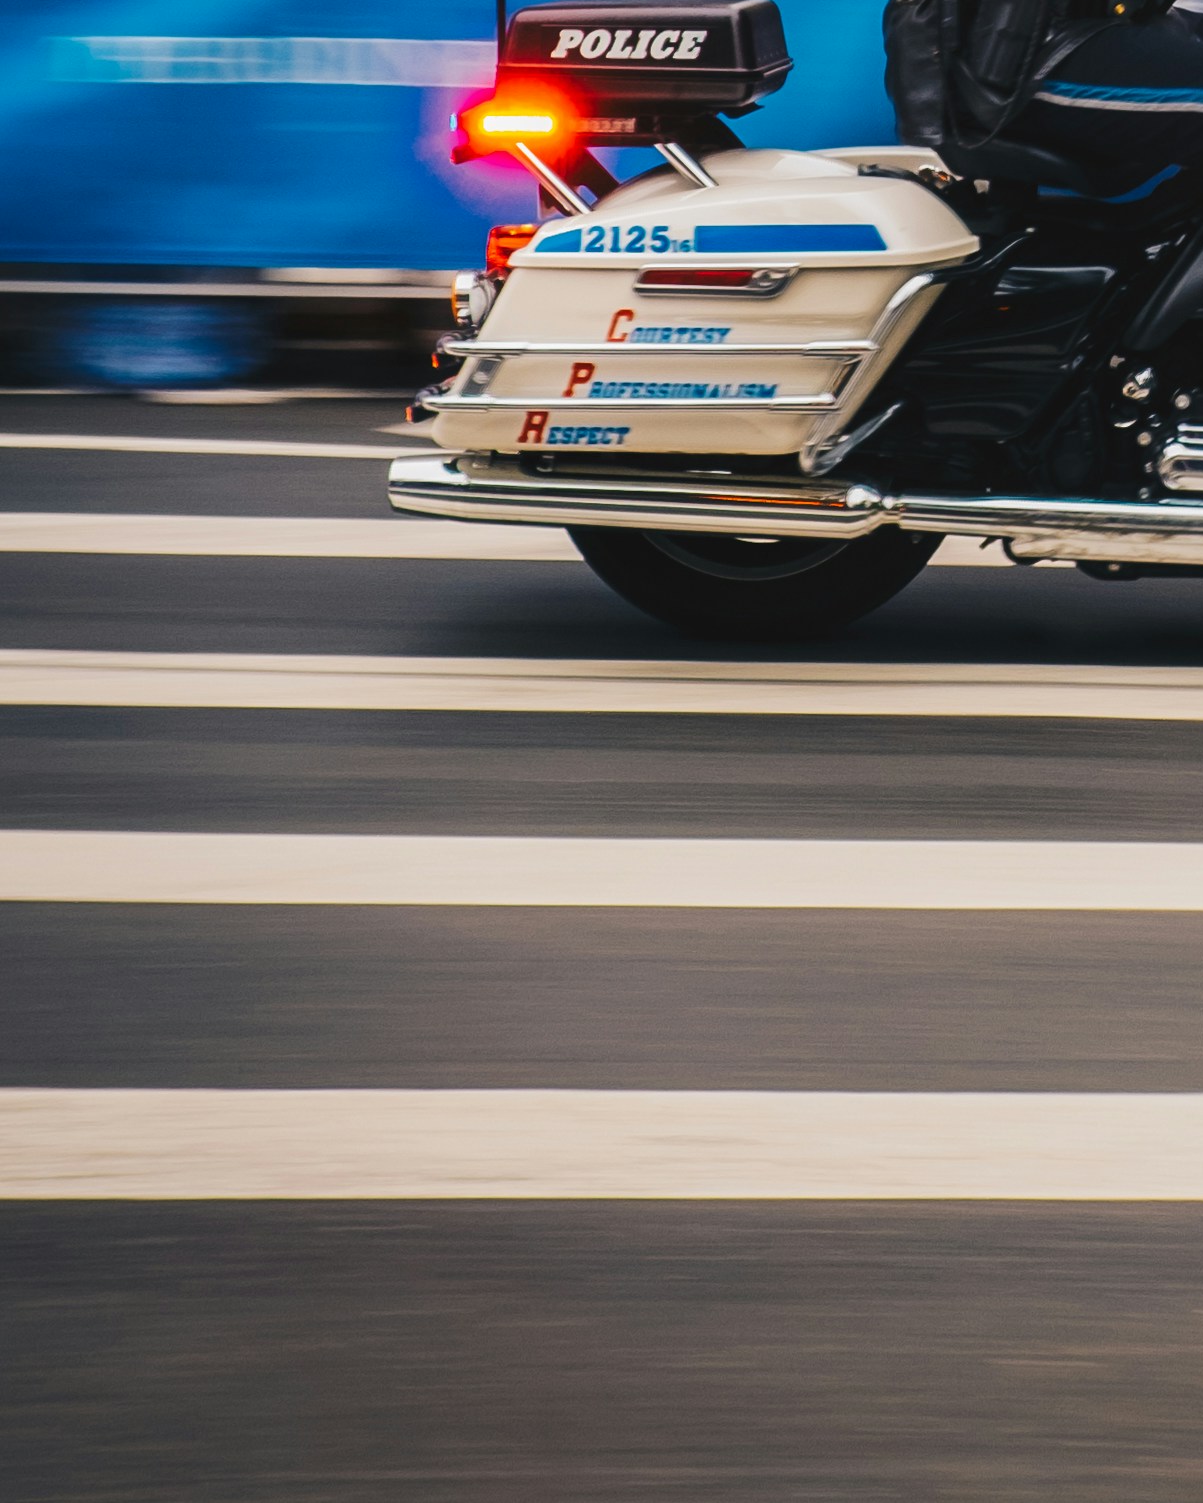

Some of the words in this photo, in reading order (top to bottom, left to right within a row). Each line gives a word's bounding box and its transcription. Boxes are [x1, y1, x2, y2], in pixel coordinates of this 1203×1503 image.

[550, 28, 708, 60] POLICE
[584, 225, 671, 253] 2125
[606, 309, 732, 344] COURTESY
[517, 410, 631, 445] RESPECT
